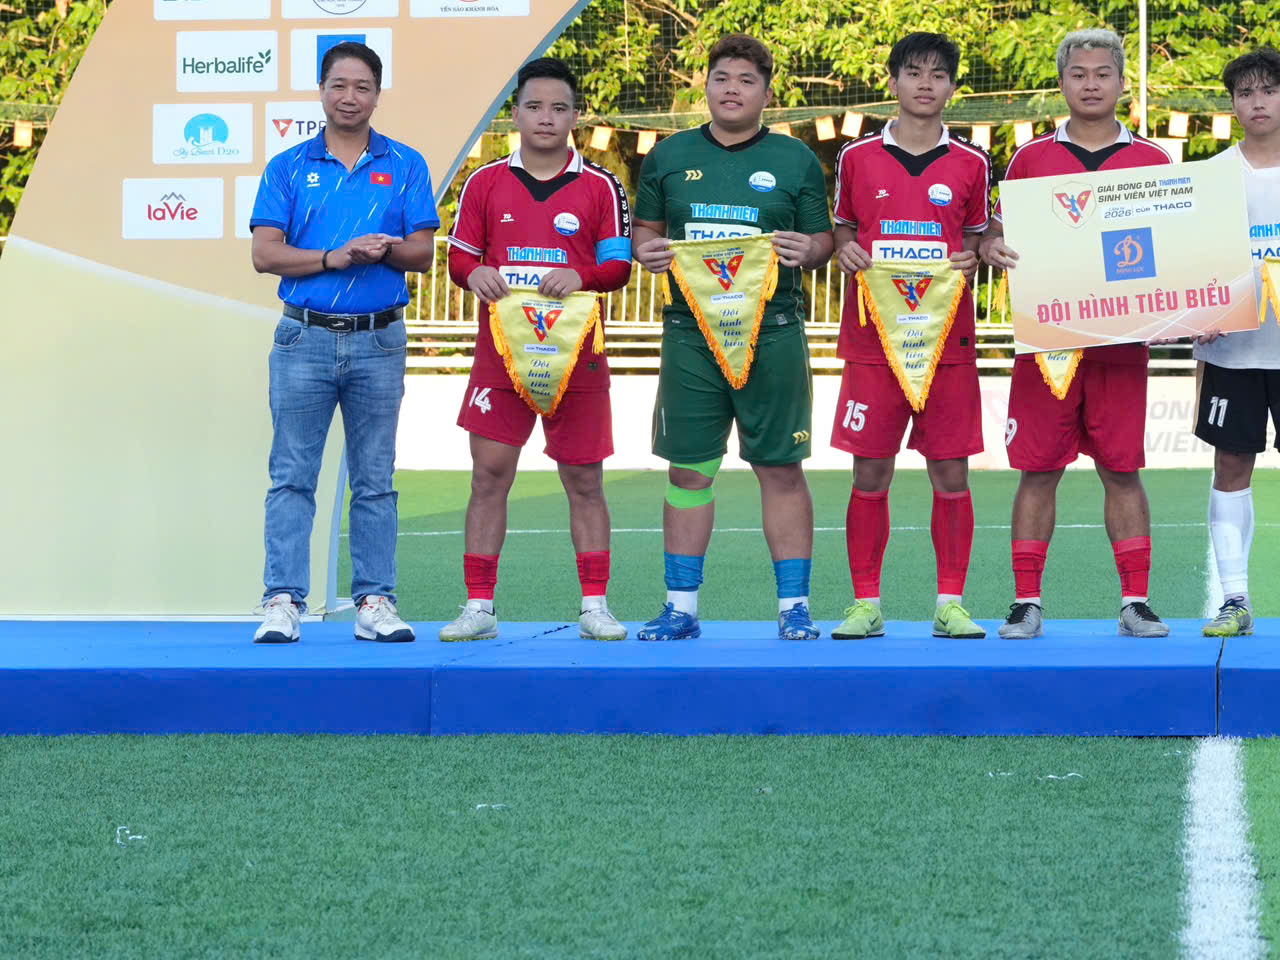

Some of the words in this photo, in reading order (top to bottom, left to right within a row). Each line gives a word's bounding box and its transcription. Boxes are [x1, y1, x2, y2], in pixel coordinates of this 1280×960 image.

[182, 56, 264, 74] Herbalife
[1098, 193, 1121, 203] SINH
[1170, 186, 1193, 197] NAM
[690, 203, 730, 219] THANH
[1104, 209, 1132, 219] 2026
[1153, 201, 1192, 212] THACO
[880, 220, 917, 235] THANH
[1250, 224, 1273, 238] ANH
[507, 246, 542, 262] THANH
[879, 247, 943, 259] THACO
[506, 273, 541, 285] THA
[1037, 298, 1071, 326] ĐỘI
[1078, 293, 1130, 320] HÌNH
[1135, 288, 1178, 314] TIÊU
[1186, 278, 1231, 309] BIỂU
[469, 386, 492, 414] 14
[843, 399, 868, 432] 15
[1207, 396, 1229, 428] 11
